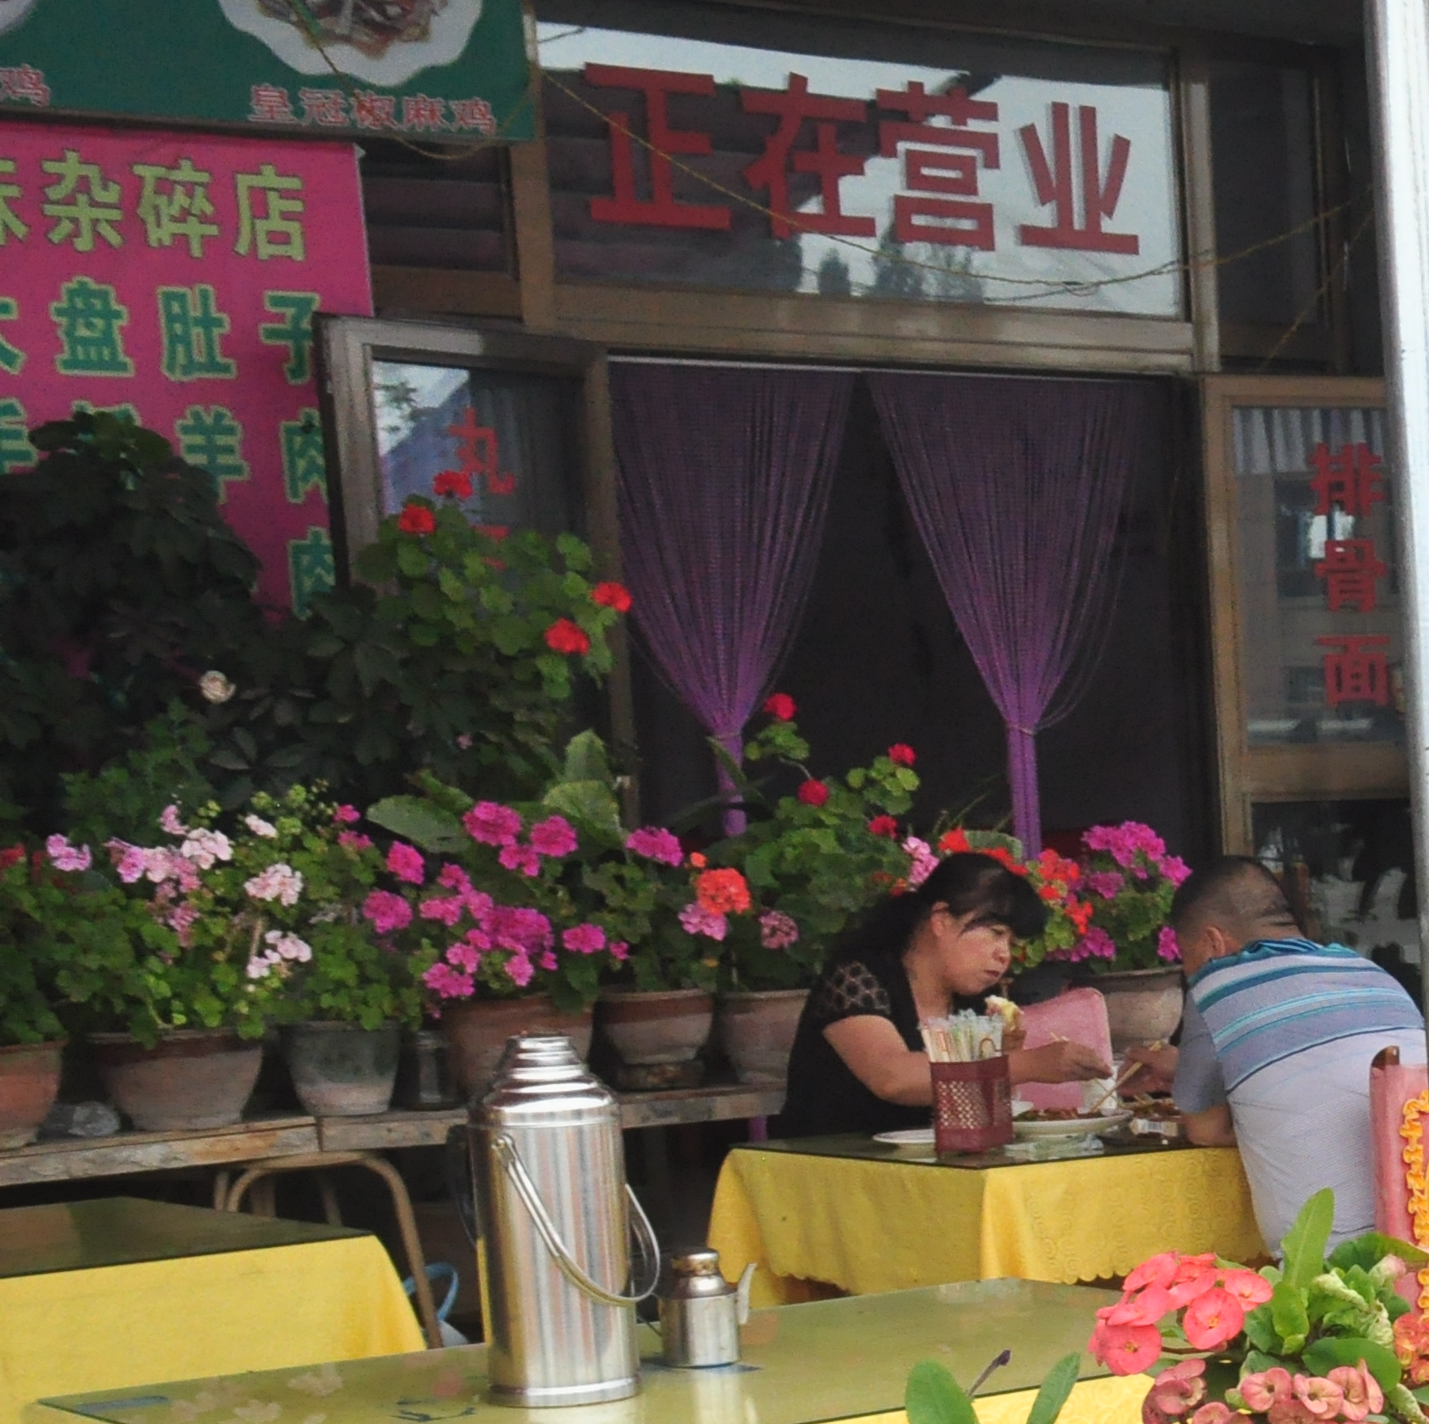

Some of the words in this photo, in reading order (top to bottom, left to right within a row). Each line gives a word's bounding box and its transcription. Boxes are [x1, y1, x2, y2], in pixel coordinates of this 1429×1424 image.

[584, 61, 1140, 256] 正在营业
[1309, 442, 1391, 708] 排骨面
